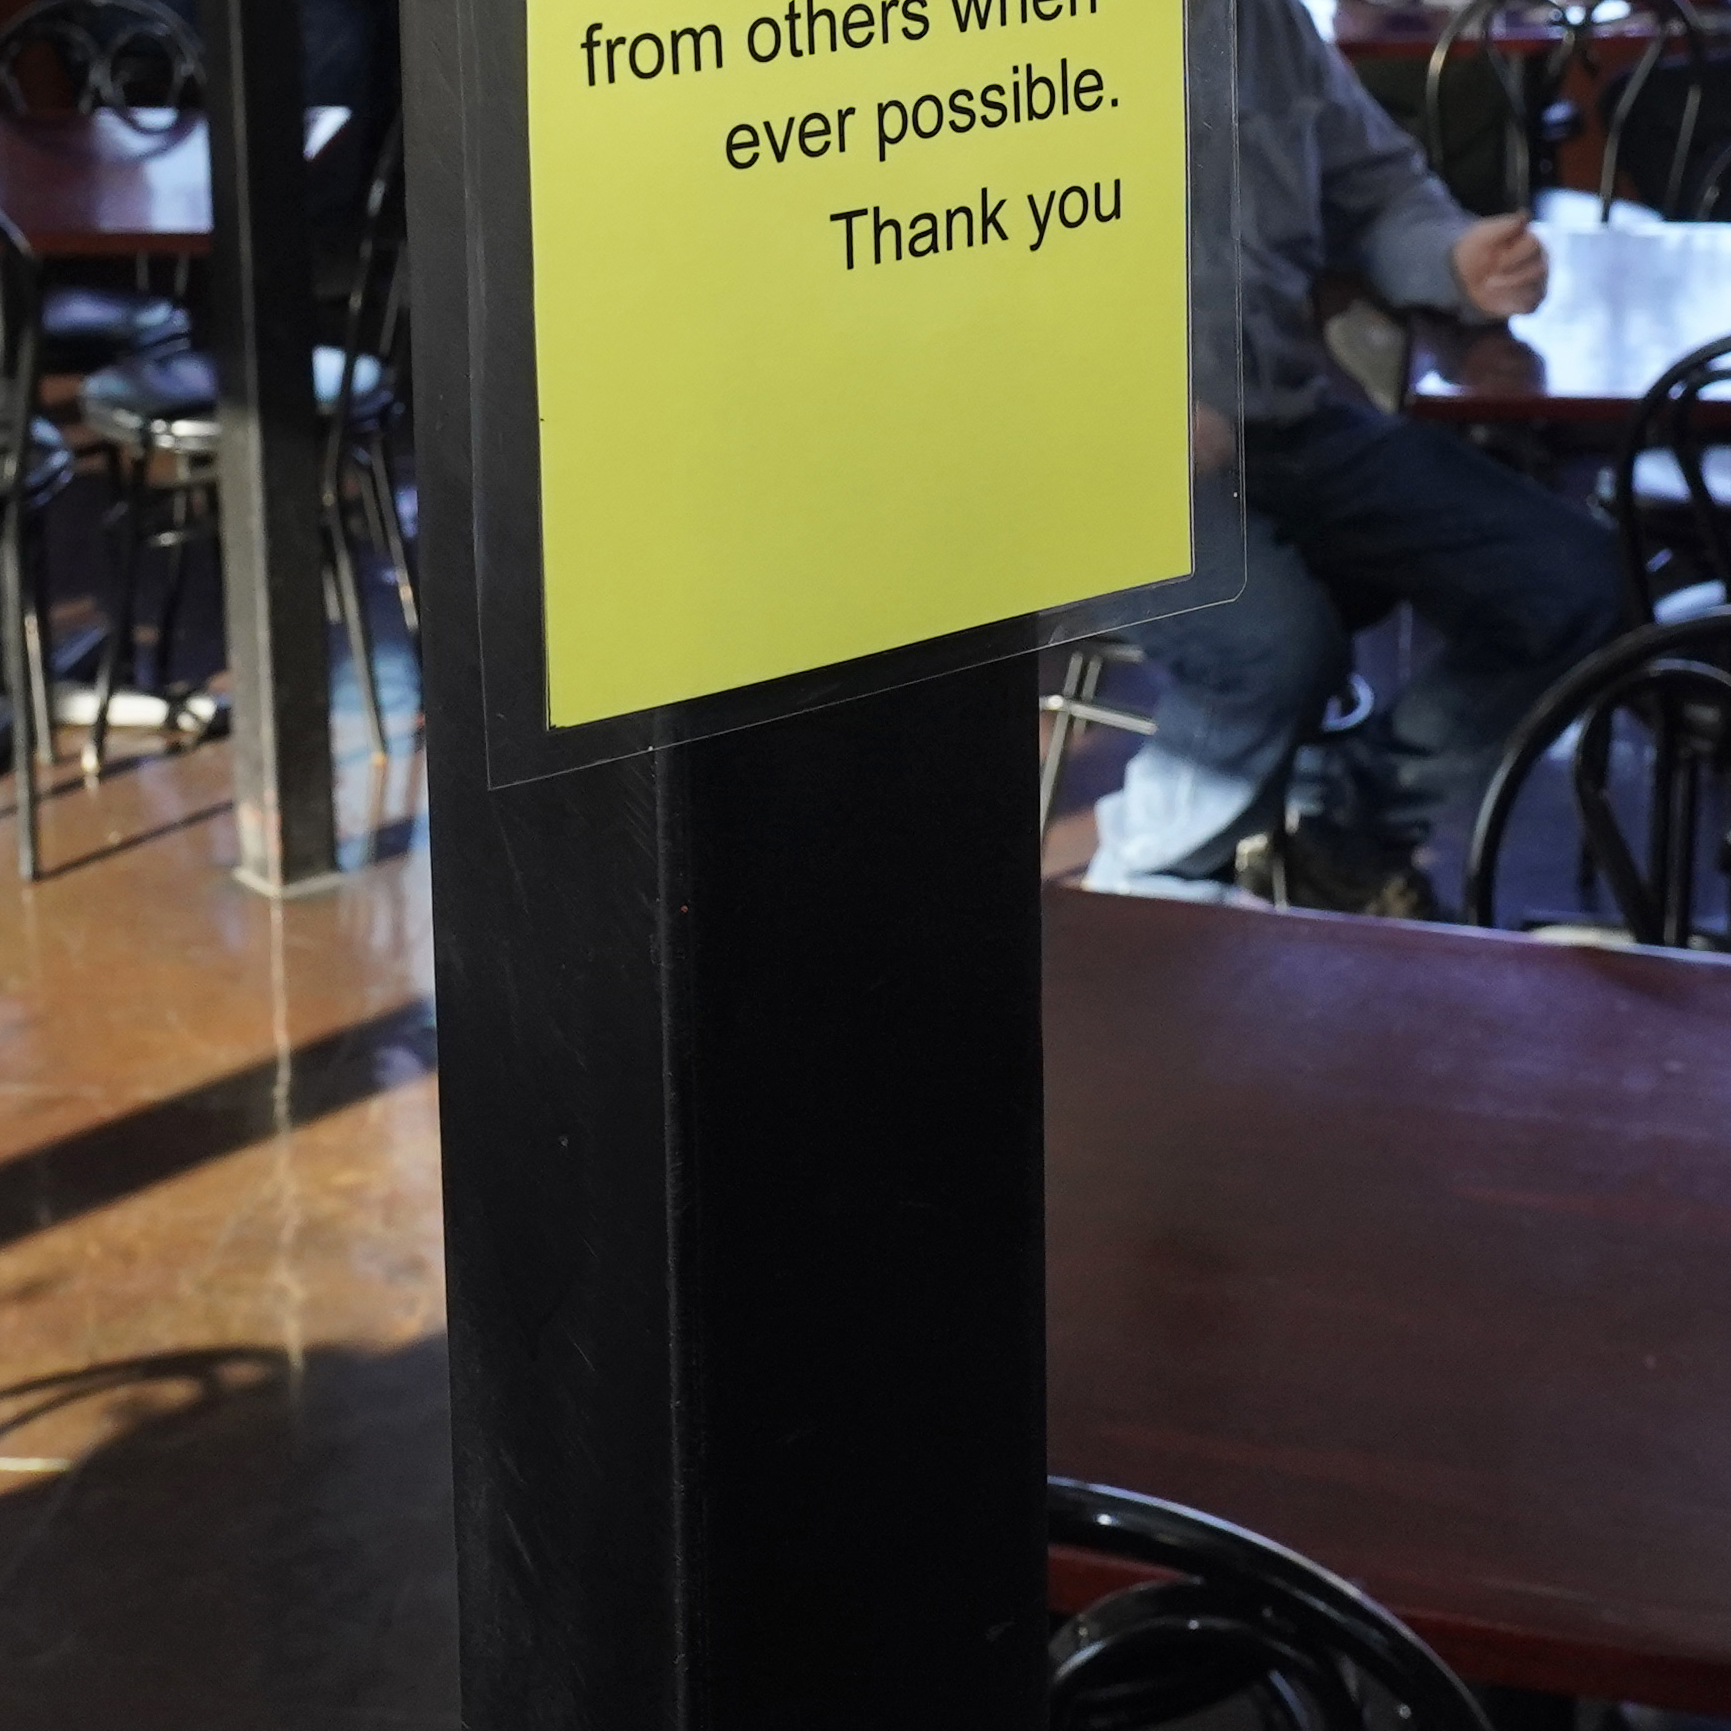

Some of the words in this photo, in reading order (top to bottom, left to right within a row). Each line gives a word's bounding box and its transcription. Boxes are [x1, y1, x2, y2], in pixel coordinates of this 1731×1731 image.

[580, 22, 724, 87] from
[725, 106, 857, 170] ever
[877, 57, 1119, 162] possible.
[829, 186, 1010, 271] Thank
[1026, 179, 1121, 252] you
